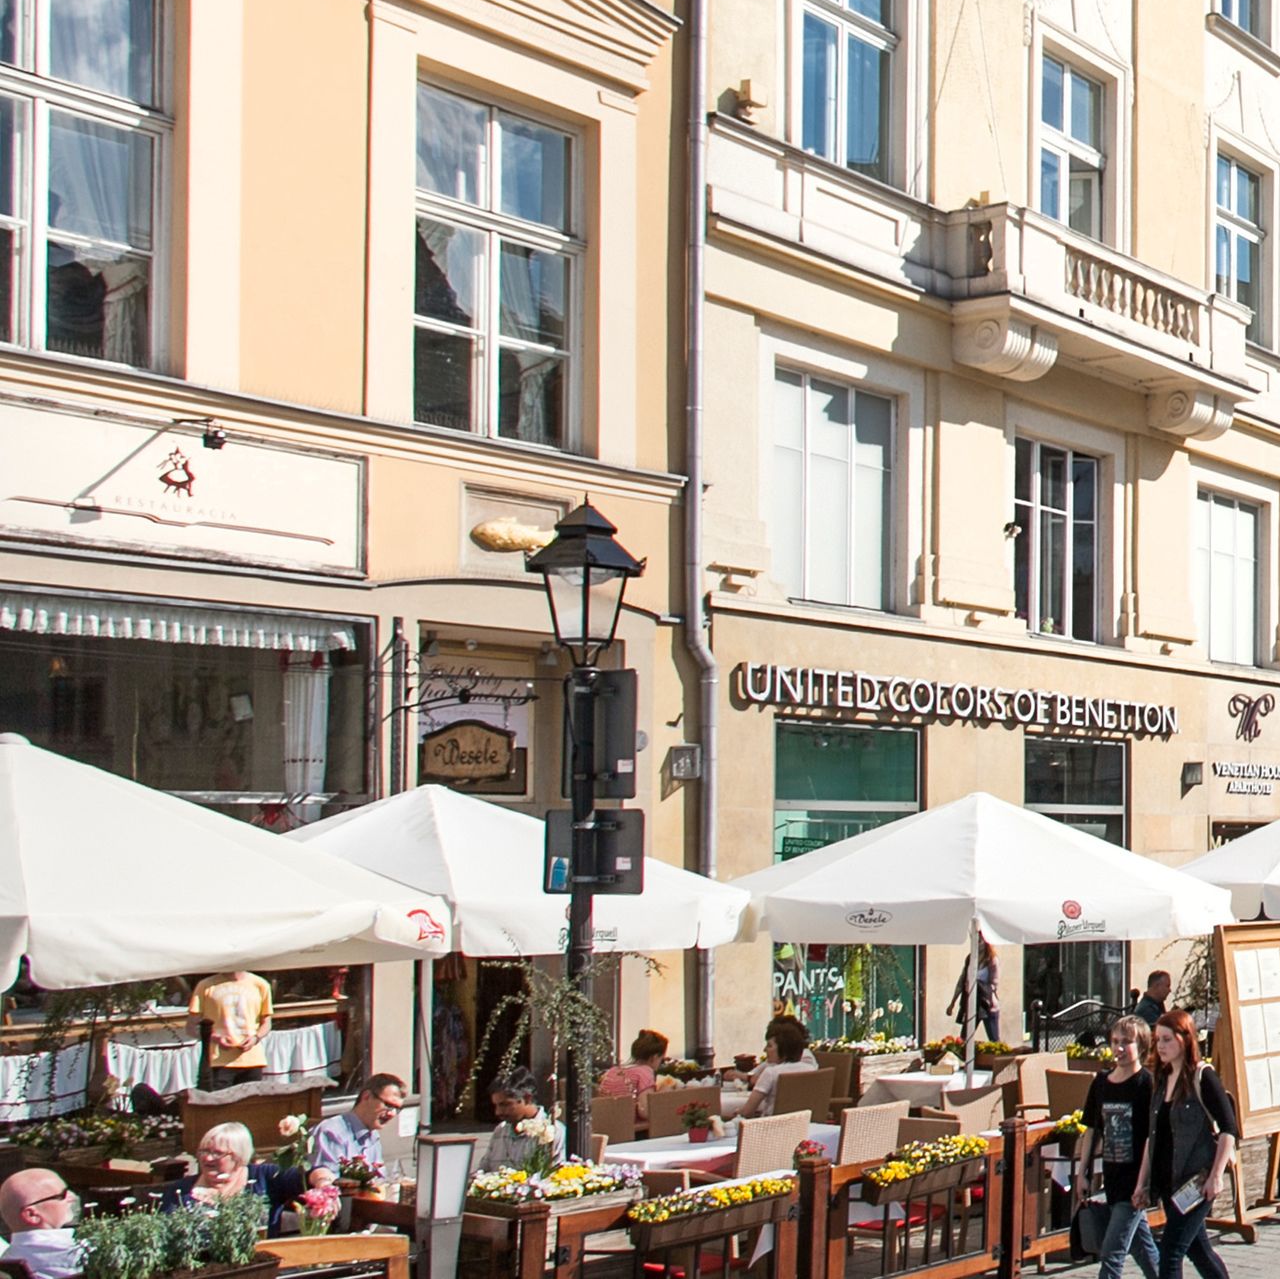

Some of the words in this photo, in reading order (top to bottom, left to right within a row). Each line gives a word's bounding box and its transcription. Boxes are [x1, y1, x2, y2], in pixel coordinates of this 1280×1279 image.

[745, 662, 881, 711] UNITED
[888, 676, 1007, 720] COLORS
[1013, 690, 1053, 724] OF
[434, 738, 501, 766] Wesele
[773, 967, 845, 997] PANTS
